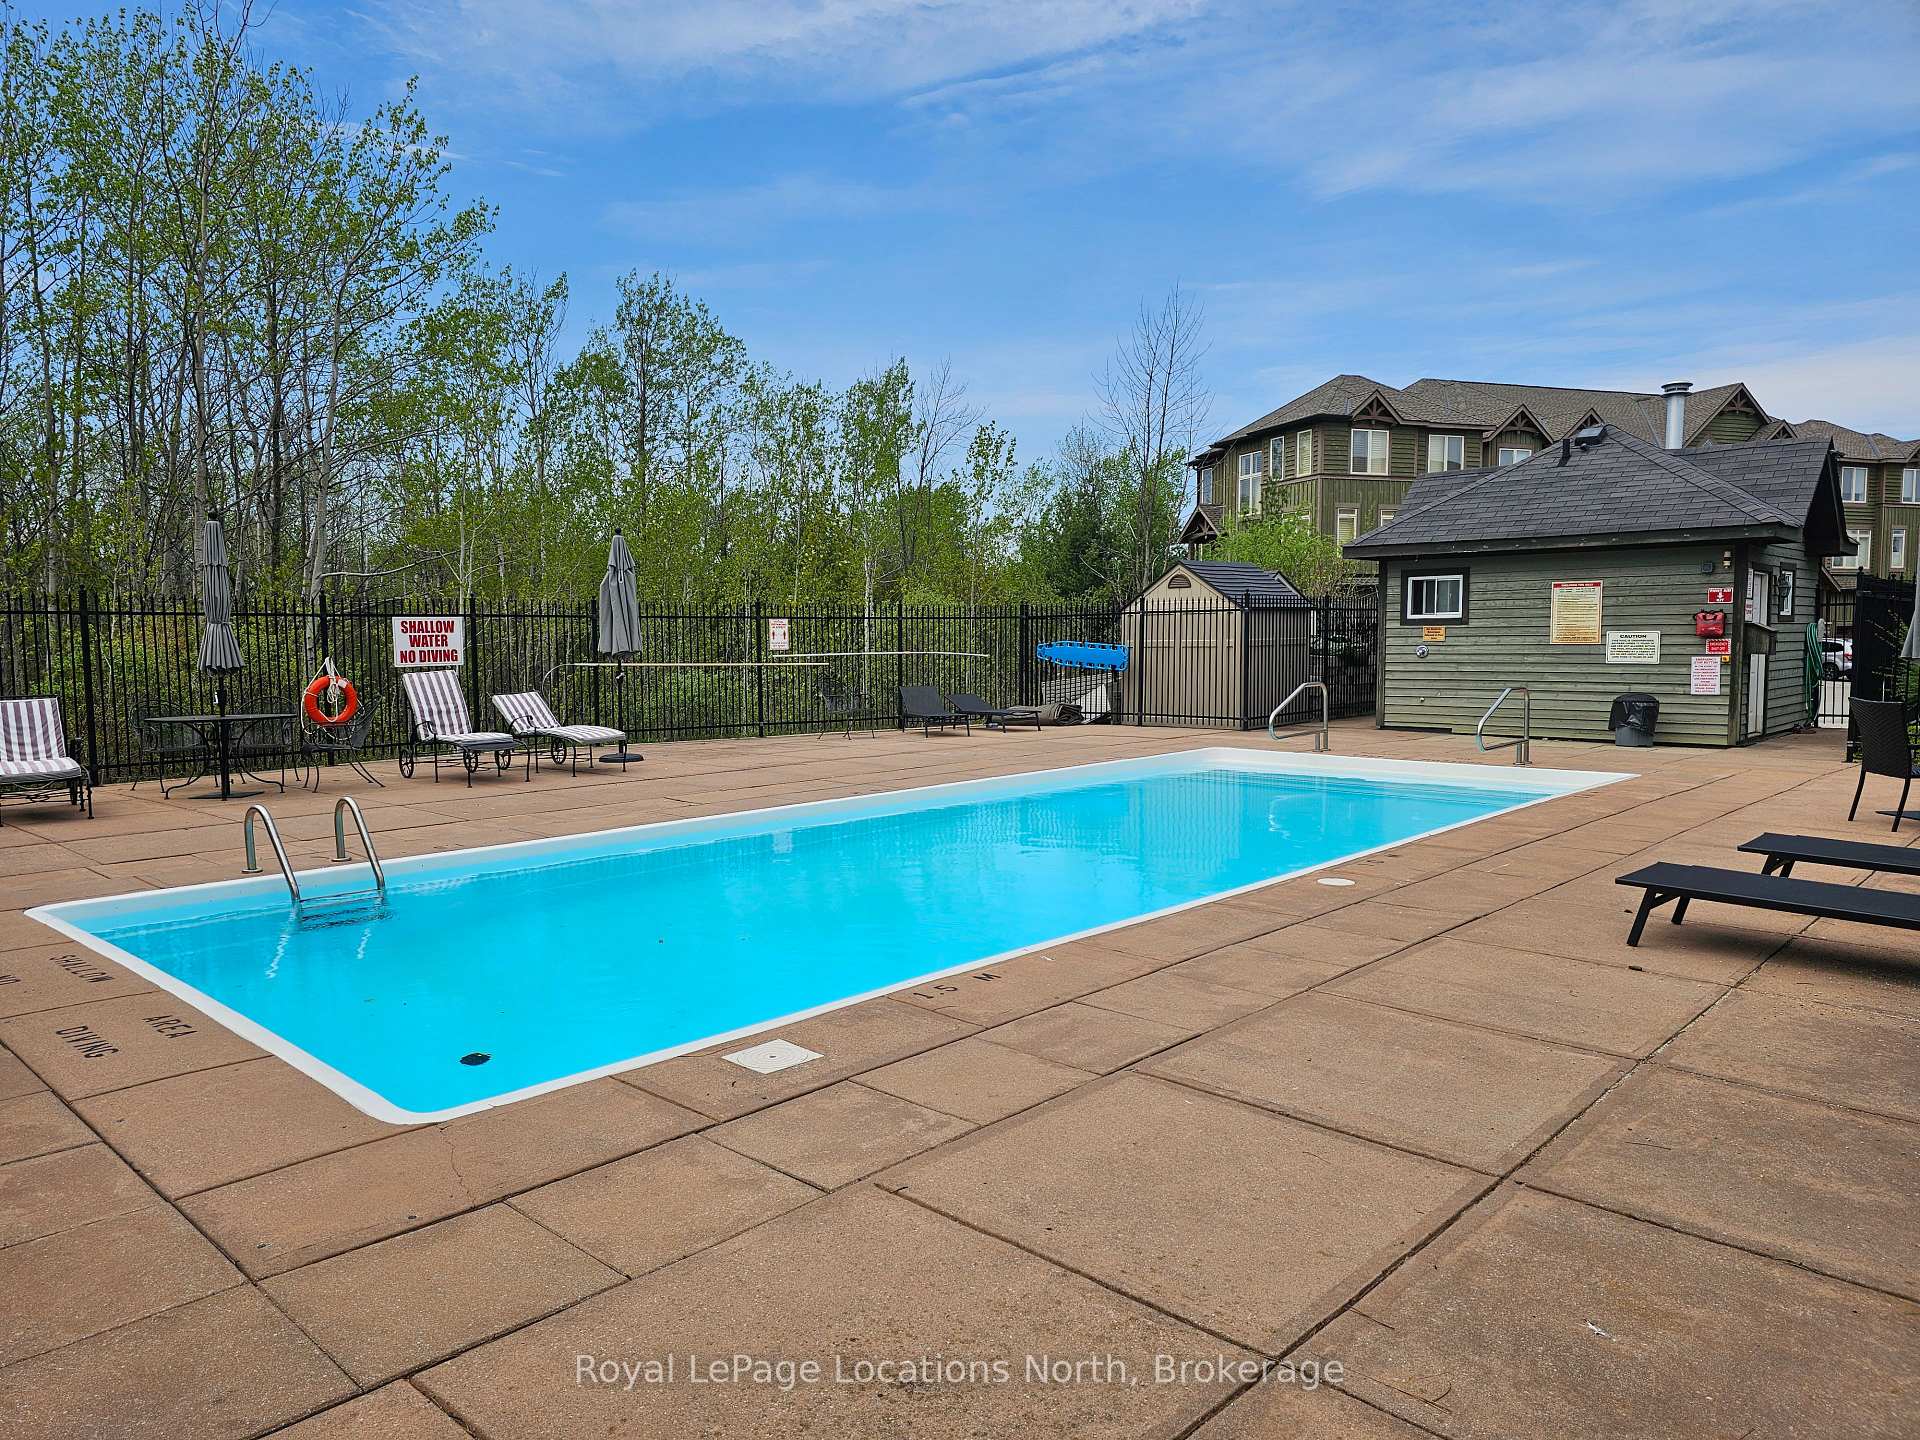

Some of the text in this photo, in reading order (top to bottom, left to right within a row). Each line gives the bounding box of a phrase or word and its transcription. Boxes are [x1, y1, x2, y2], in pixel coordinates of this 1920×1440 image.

[400, 620, 455, 634] SHALLOW
[408, 634, 449, 648] WATER
[400, 649, 459, 664] NO DIVING
[48, 953, 115, 983] SHALLOW
[972, 972, 1002, 982] M
[141, 1014, 198, 1039] AREA
[55, 1025, 120, 1059] DIVING
